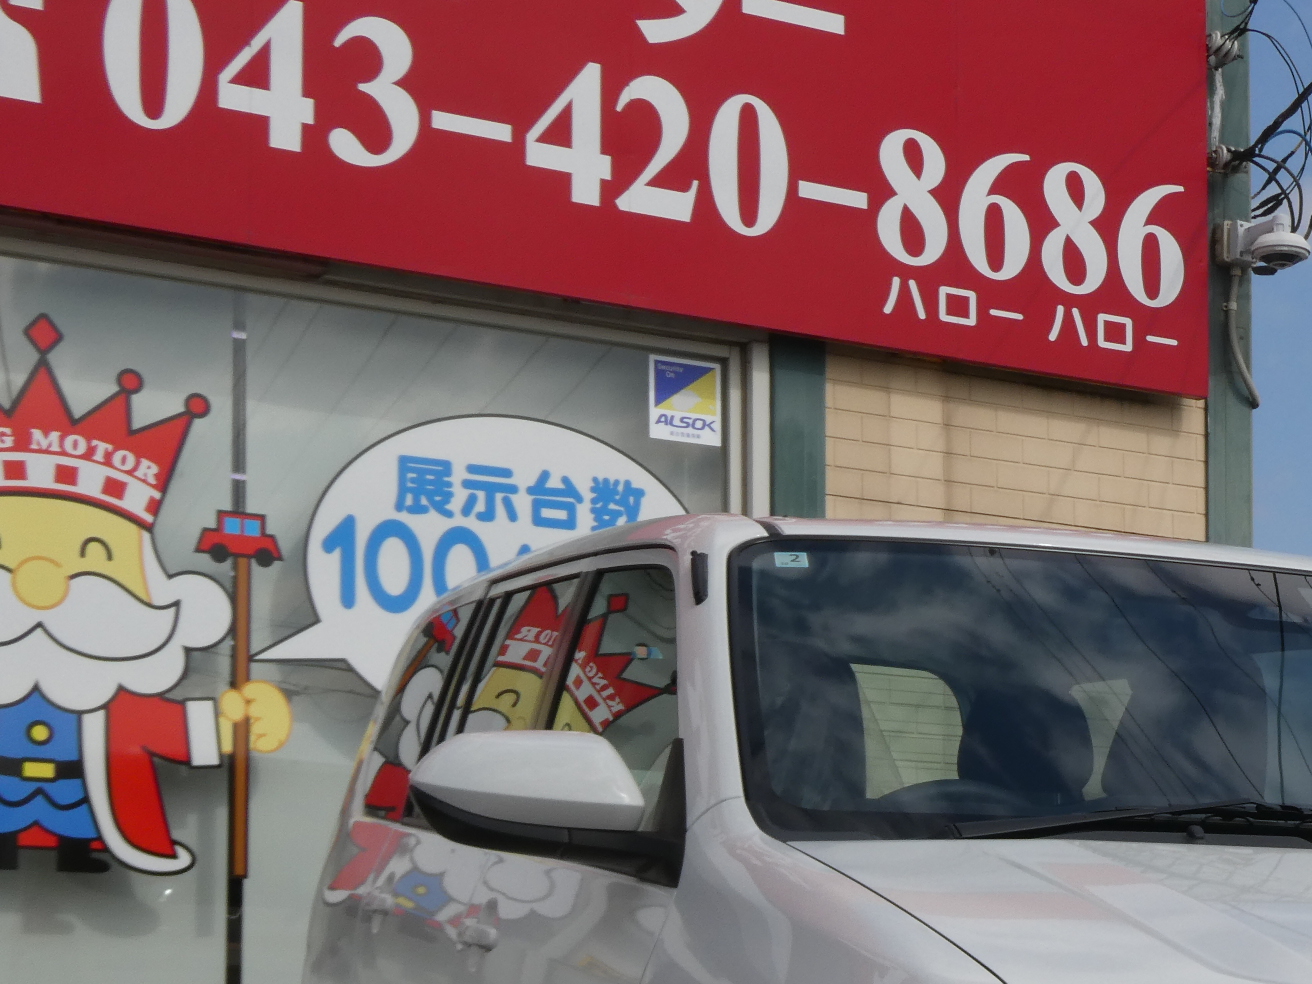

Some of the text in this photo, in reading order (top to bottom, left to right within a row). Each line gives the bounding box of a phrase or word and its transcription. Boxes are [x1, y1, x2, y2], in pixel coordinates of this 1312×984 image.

[102, 0, 1185, 308] 043-420-8686
[883, 276, 1179, 353] ハロー ハロー
[29, 428, 160, 485] MOTOR
[655, 413, 717, 433] ALSOK
[394, 454, 646, 532] 展示台数
